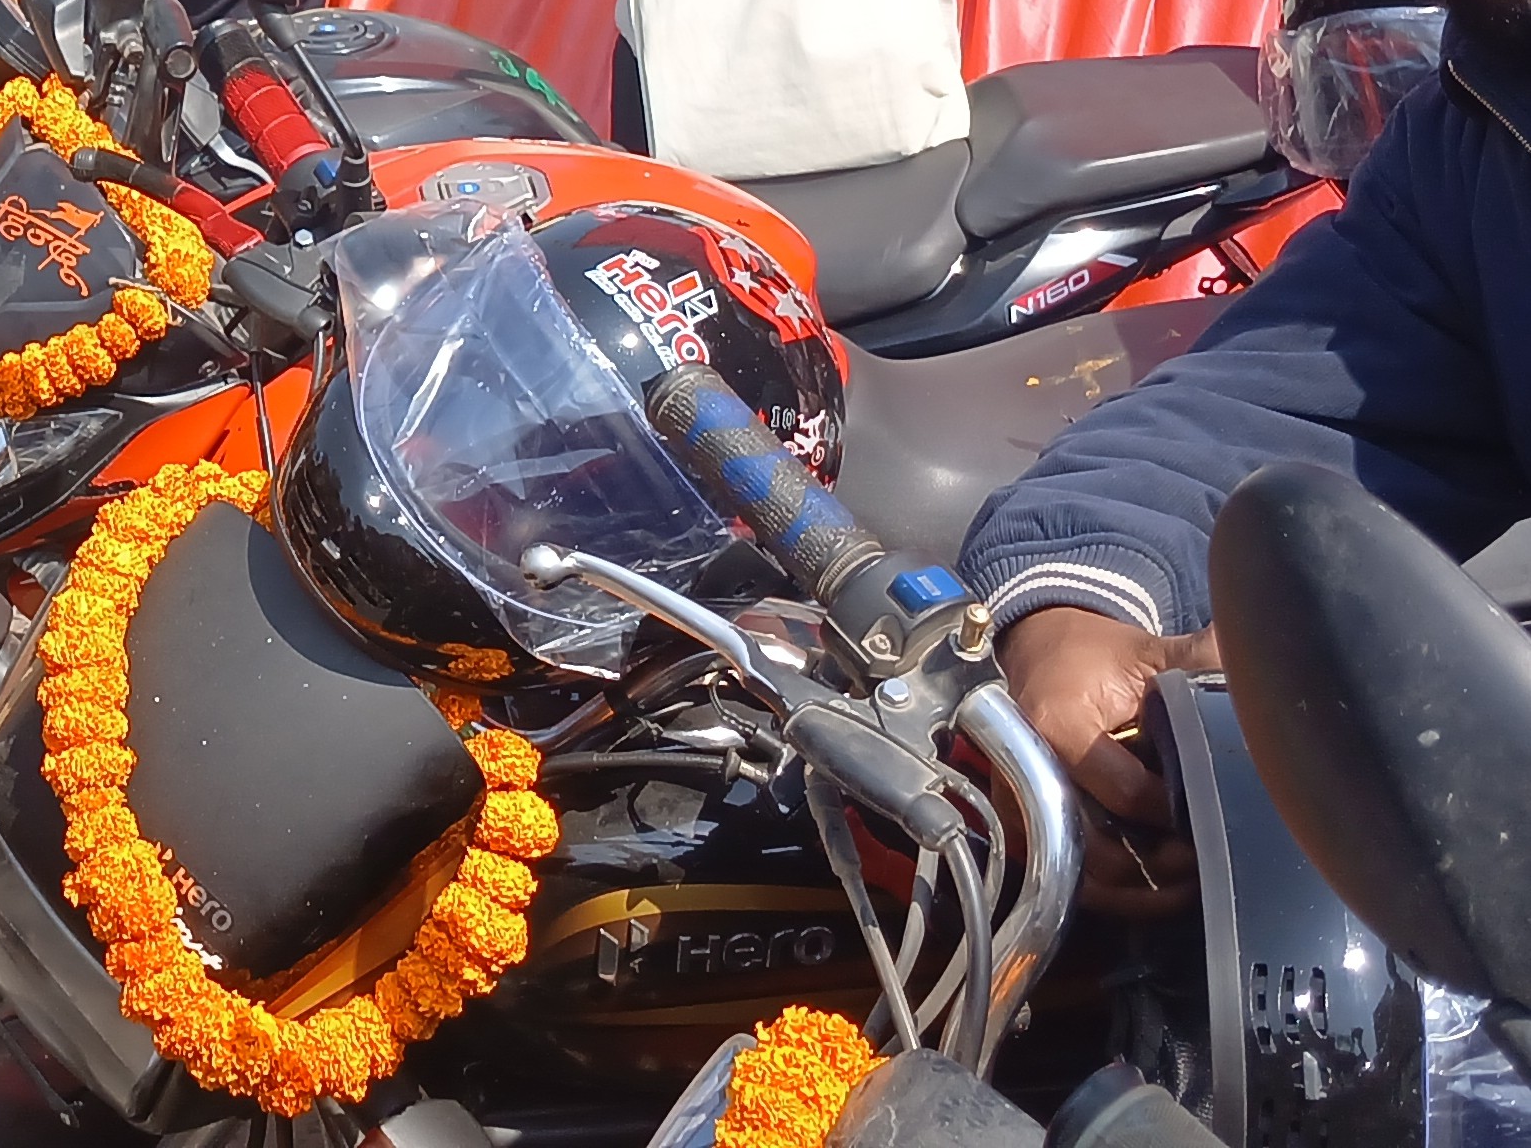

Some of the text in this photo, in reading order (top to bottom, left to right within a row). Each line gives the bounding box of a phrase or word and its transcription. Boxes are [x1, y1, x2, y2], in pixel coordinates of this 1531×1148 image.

[596, 253, 710, 366] Hero
[1009, 268, 1091, 325] N160
[172, 866, 233, 932] Hero
[676, 926, 835, 974] Hero
